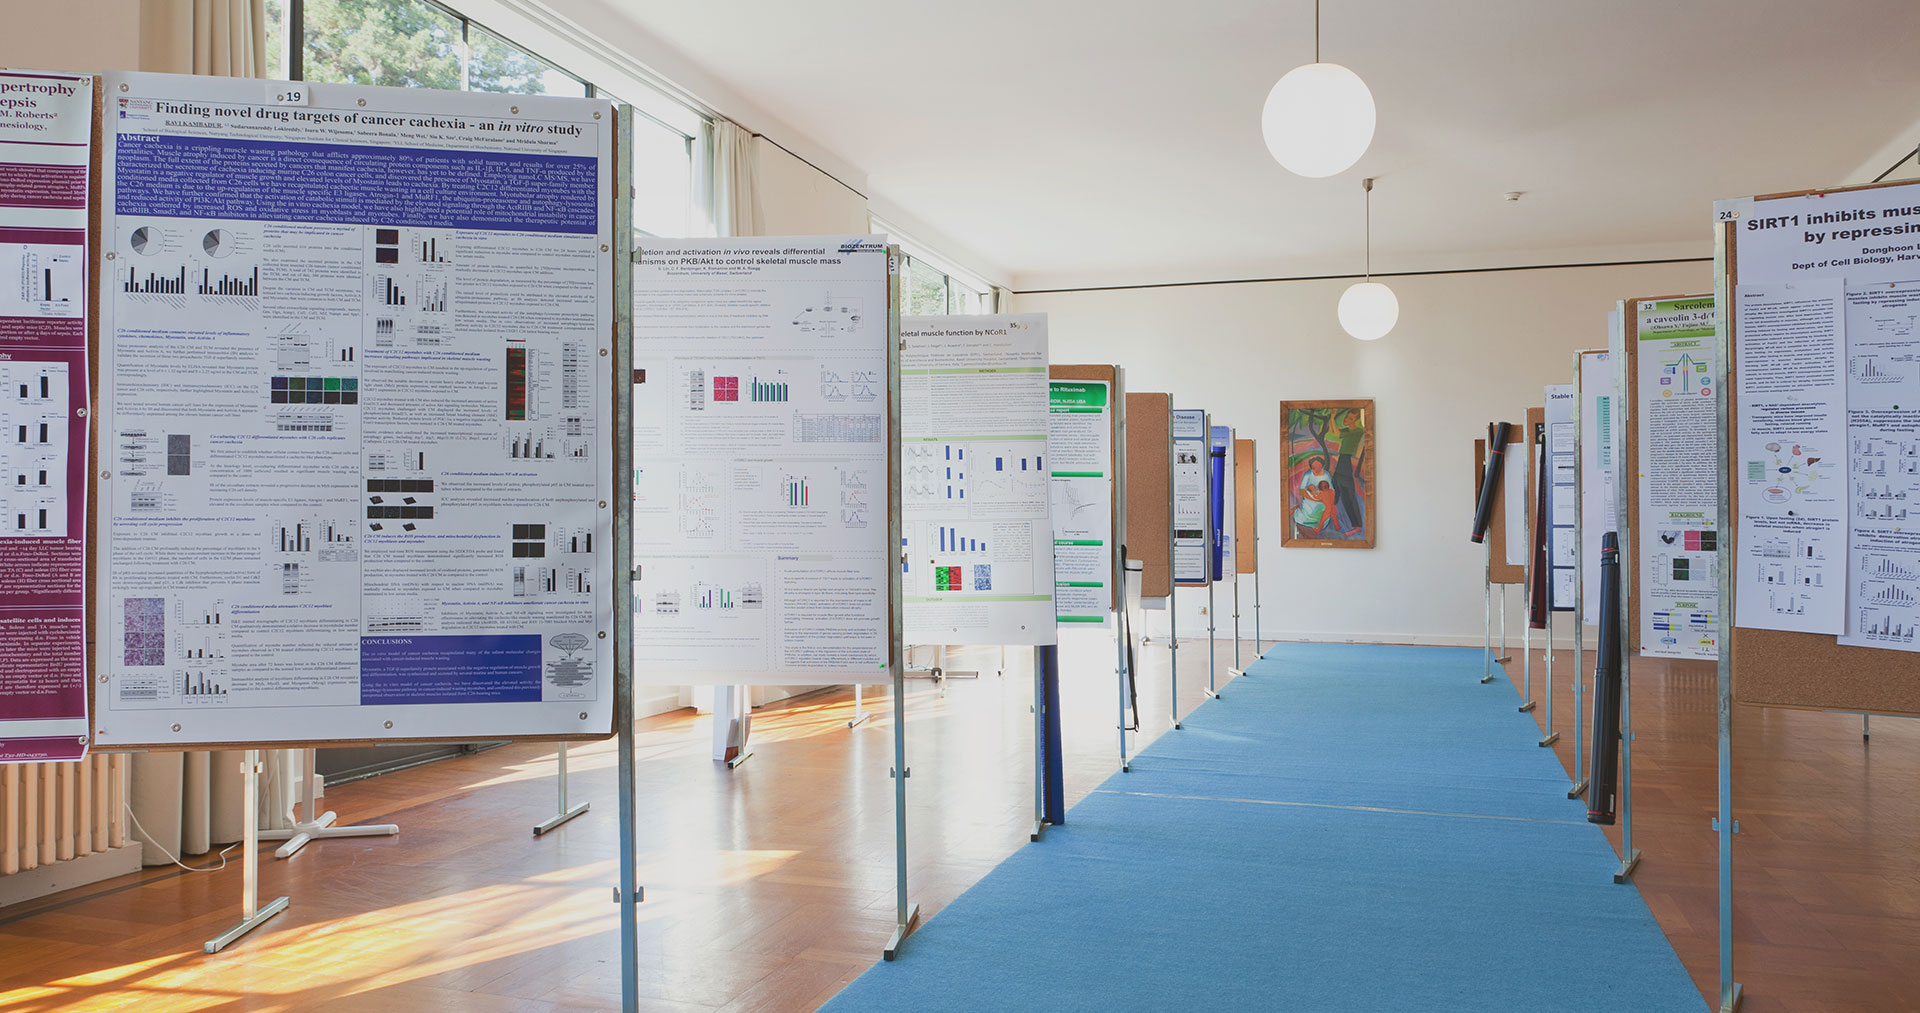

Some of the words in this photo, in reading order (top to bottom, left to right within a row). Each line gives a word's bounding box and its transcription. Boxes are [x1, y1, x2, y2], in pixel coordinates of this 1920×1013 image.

[0, 97, 37, 109] epsis
[287, 92, 301, 101] 19
[156, 102, 210, 118] Finding
[215, 107, 251, 118] novel
[256, 108, 289, 122] drug
[294, 111, 340, 124] targets
[344, 113, 358, 123] of
[361, 116, 406, 126] cancer
[410, 118, 465, 129] cachexia
[479, 122, 494, 131] an
[499, 121, 511, 131] in
[516, 122, 543, 133] vitro
[548, 125, 582, 138] study
[192, 145, 220, 154] crippling
[250, 148, 274, 156] wasting
[278, 149, 309, 158] pathology
[352, 153, 395, 162] approximately
[426, 156, 449, 164] patients
[183, 151, 207, 159] atrophy
[354, 159, 387, 168] circulating
[389, 161, 410, 169] protein
[412, 162, 449, 171] components
[548, 168, 575, 177] produced
[1720, 211, 1732, 219] 24
[1747, 215, 1799, 231] SIRT1
[1806, 209, 1876, 225] inhibits
[1883, 206, 1920, 218] mus
[1804, 231, 1825, 244] by
[1832, 222, 1920, 241] repressin
[1862, 246, 1913, 254] Donghoon
[1654, 314, 1689, 323] caveolin
